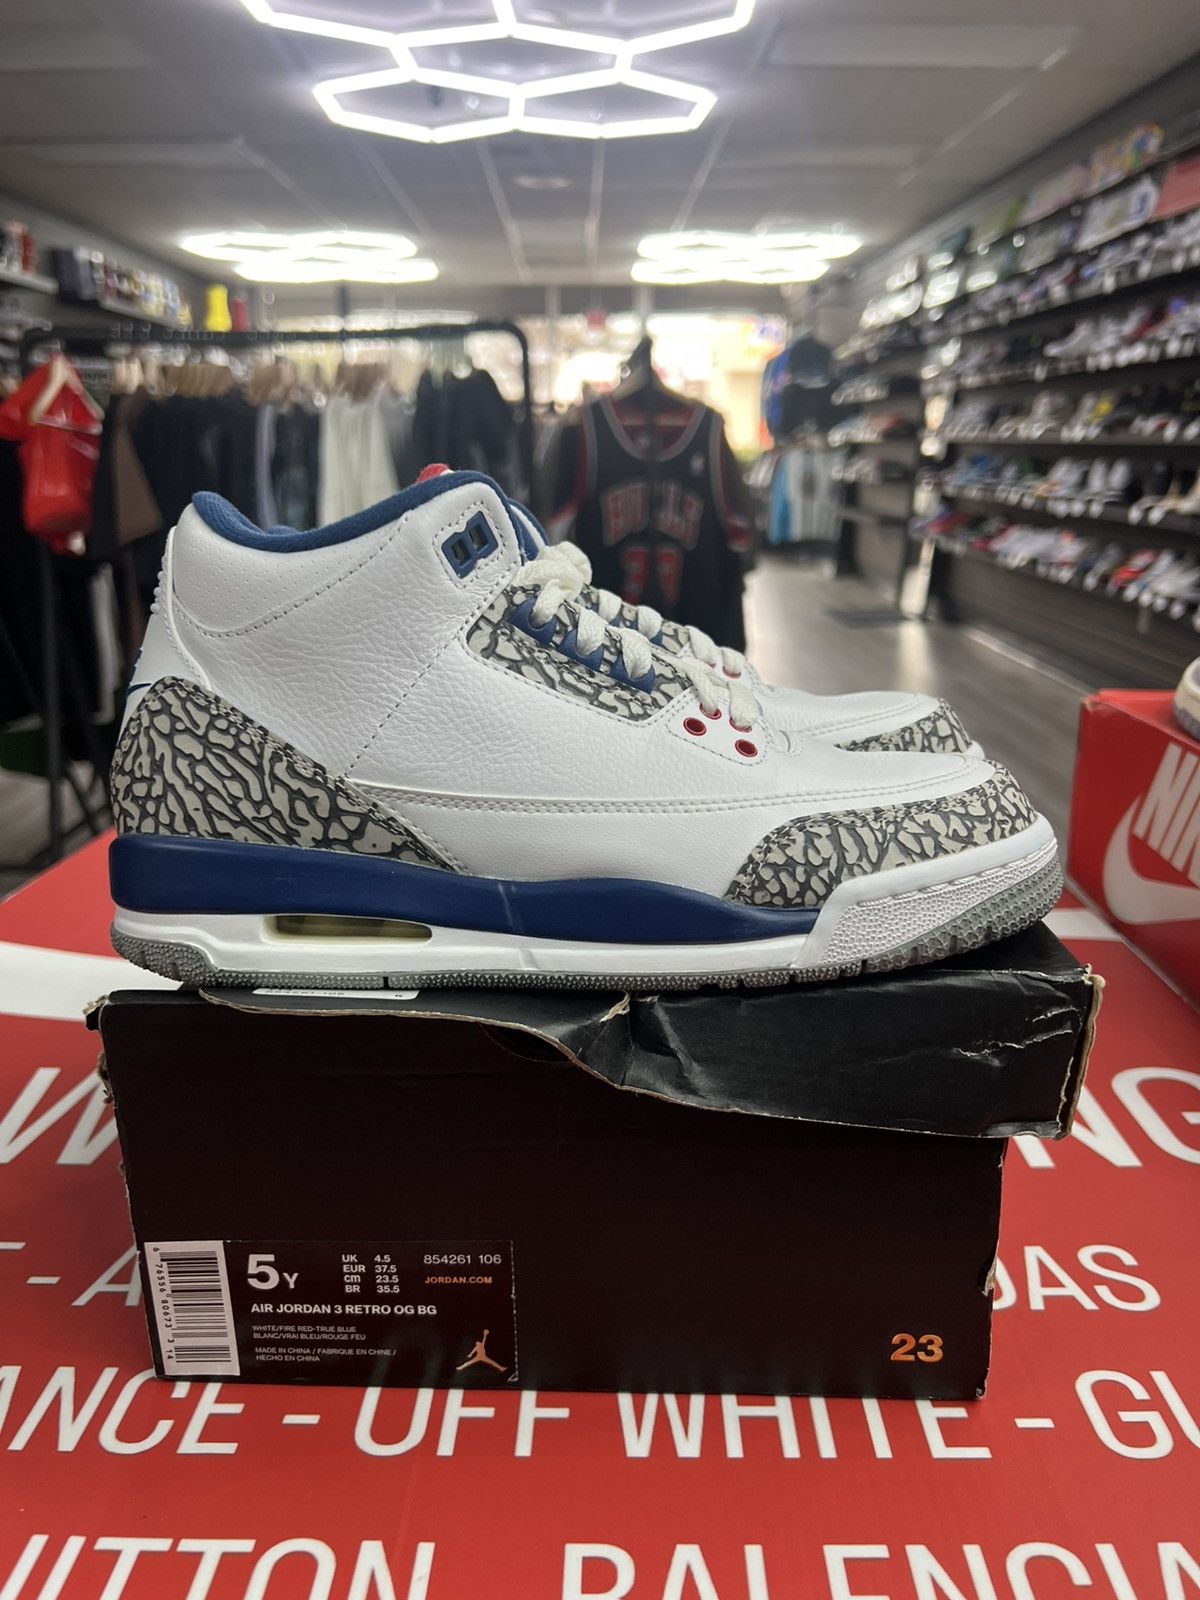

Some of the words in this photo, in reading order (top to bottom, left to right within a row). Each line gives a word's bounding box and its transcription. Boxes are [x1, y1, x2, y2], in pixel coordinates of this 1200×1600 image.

[342, 1255, 358, 1263] UK
[374, 1255, 391, 1263] 4.5
[423, 1254, 471, 1265] 854261
[478, 1254, 502, 1265] 106
[343, 1265, 366, 1273] EUR
[374, 1265, 397, 1273] 37.5
[344, 1275, 361, 1283] cm
[375, 1275, 399, 1283] 23.5
[424, 1276, 493, 1284] JORDAN.COM
[345, 1285, 361, 1293] BR
[376, 1285, 400, 1293] 35.5
[251, 1303, 274, 1314] AIR
[276, 1303, 331, 1315] JORDAN
[334, 1305, 343, 1315] 3
[345, 1305, 391, 1315] RETRO
[394, 1305, 415, 1316] OG
[417, 1305, 438, 1316] BG
[297, 1325, 335, 1333] RED-TRUE
[317, 1347, 355, 1355] FABRIQUE
[368, 1348, 392, 1356] CHINE
[891, 1333, 944, 1363] 23
